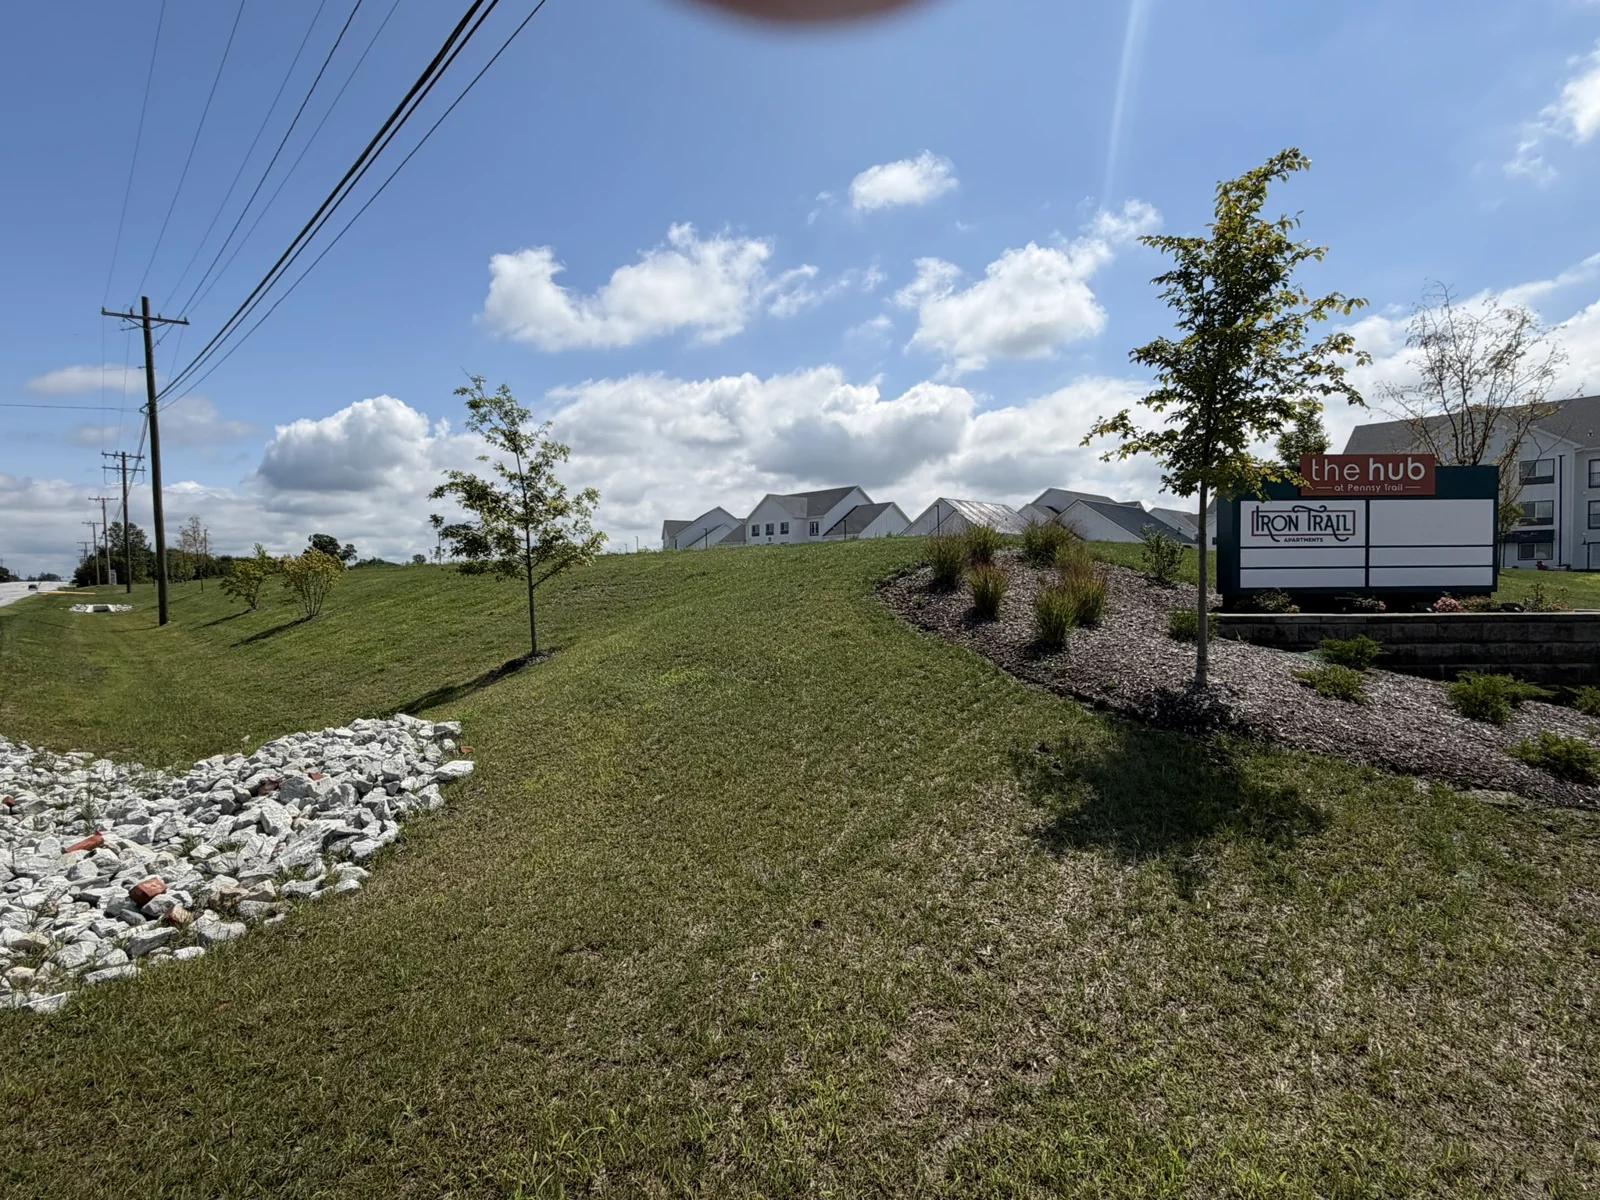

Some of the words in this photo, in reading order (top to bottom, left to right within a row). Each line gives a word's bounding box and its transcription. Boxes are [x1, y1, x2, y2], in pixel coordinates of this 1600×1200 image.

[1312, 458, 1360, 481] the
[1369, 457, 1425, 481] hub
[1334, 484, 1344, 492] at
[1348, 484, 1381, 492] Pennsy
